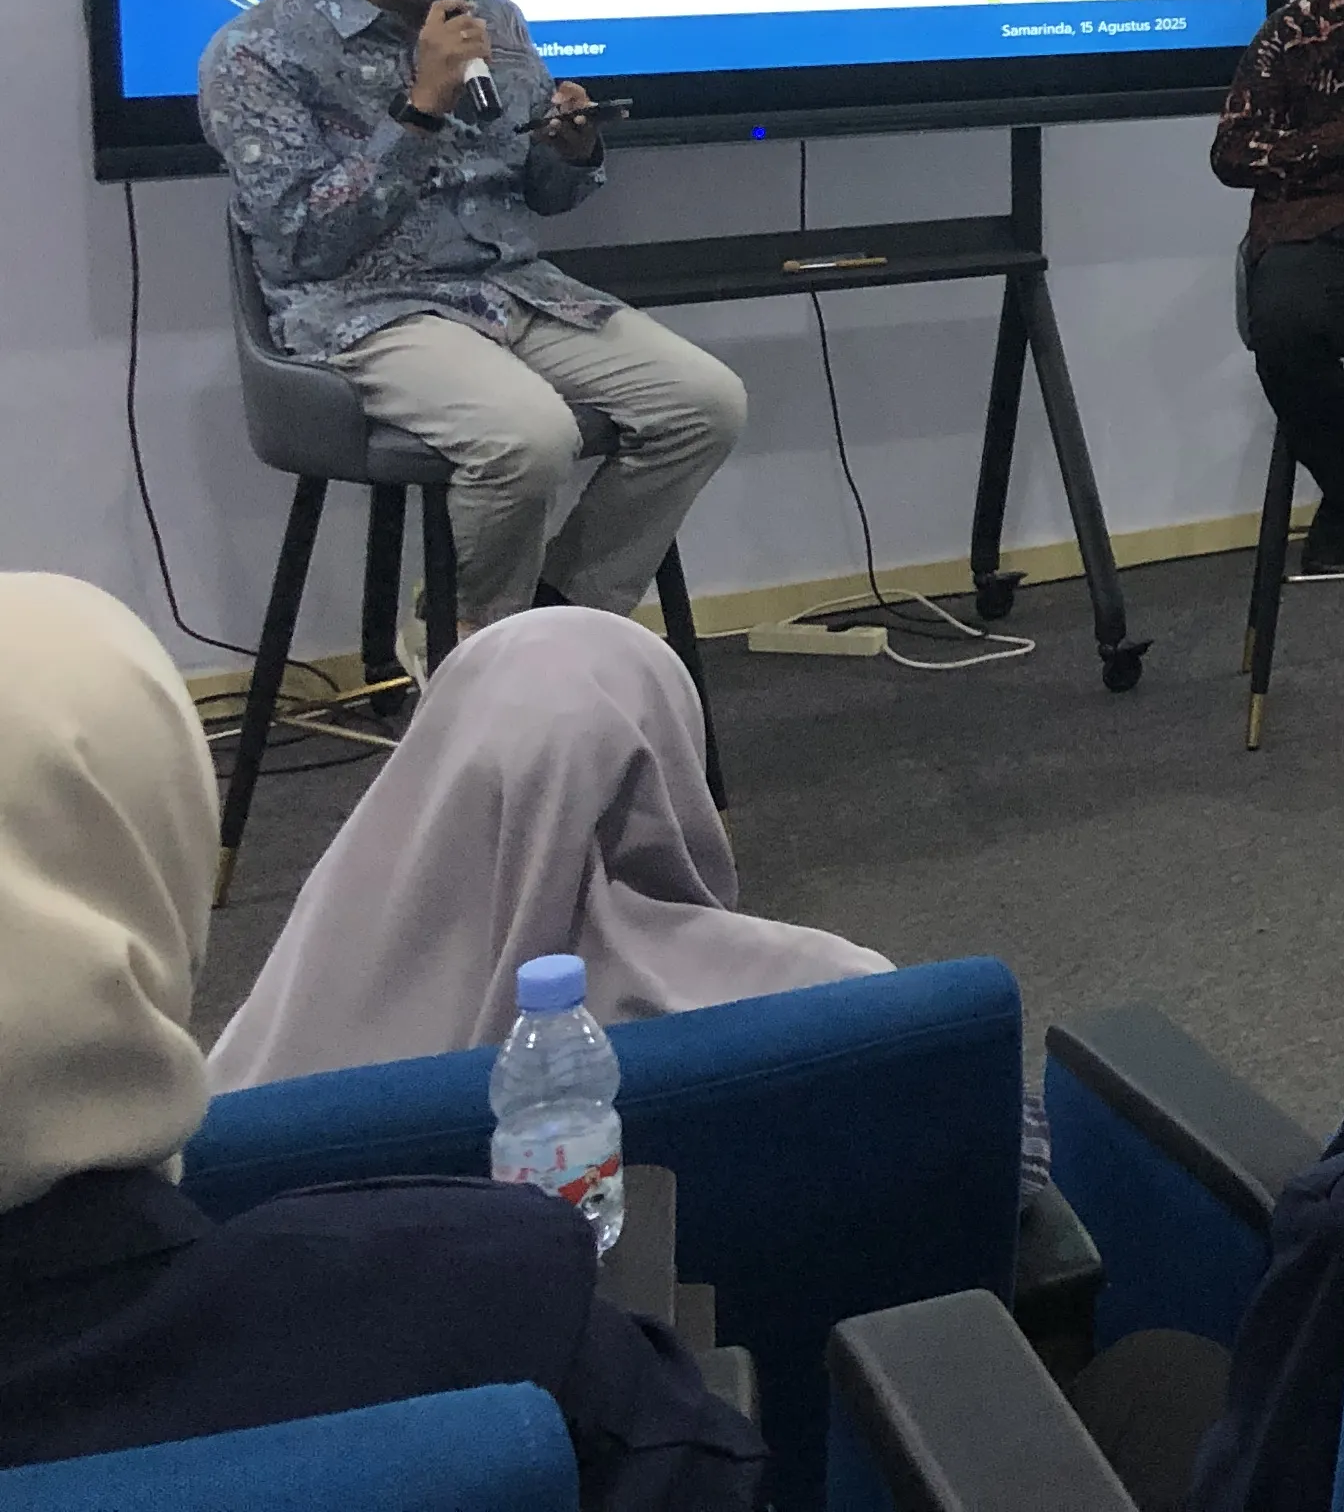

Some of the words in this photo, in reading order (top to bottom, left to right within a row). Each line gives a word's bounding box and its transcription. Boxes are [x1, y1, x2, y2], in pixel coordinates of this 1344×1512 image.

[1003, 23, 1075, 36] Samarinda,
[1080, 22, 1093, 33] 15
[1098, 21, 1150, 35] Agustus
[1155, 18, 1186, 30] 2025
[532, 43, 606, 56] hitheater
